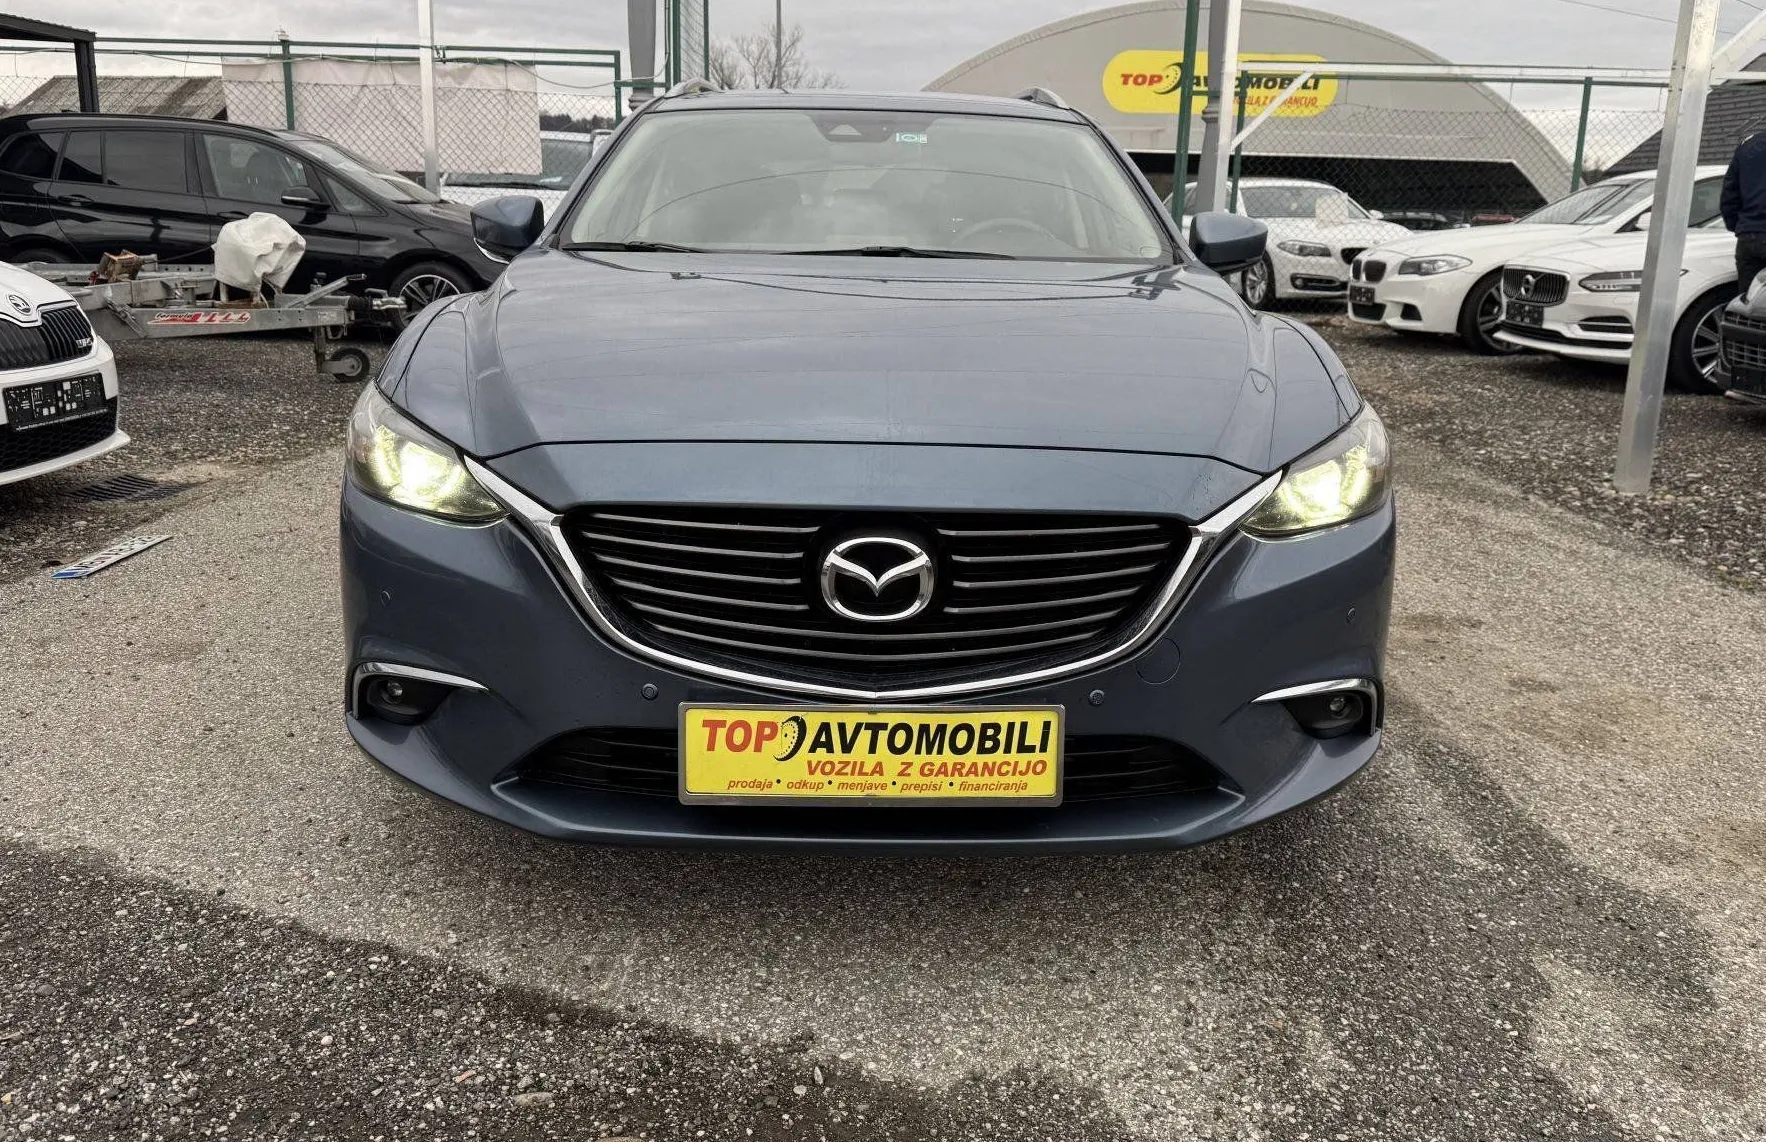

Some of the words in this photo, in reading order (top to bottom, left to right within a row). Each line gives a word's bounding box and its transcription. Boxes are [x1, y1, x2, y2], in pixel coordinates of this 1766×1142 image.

[1121, 73, 1163, 86] TOP
[702, 719, 779, 752] TOP
[808, 720, 1052, 755] AVTOMOBILI
[807, 760, 884, 777] VOZILA
[897, 761, 914, 777] Z
[919, 759, 1048, 778] GARANCIJO
[727, 779, 773, 790] prodaja
[786, 780, 824, 792] odkup
[837, 781, 888, 793] menjave
[900, 781, 943, 793] prepisi
[958, 780, 1028, 793] financiranja
